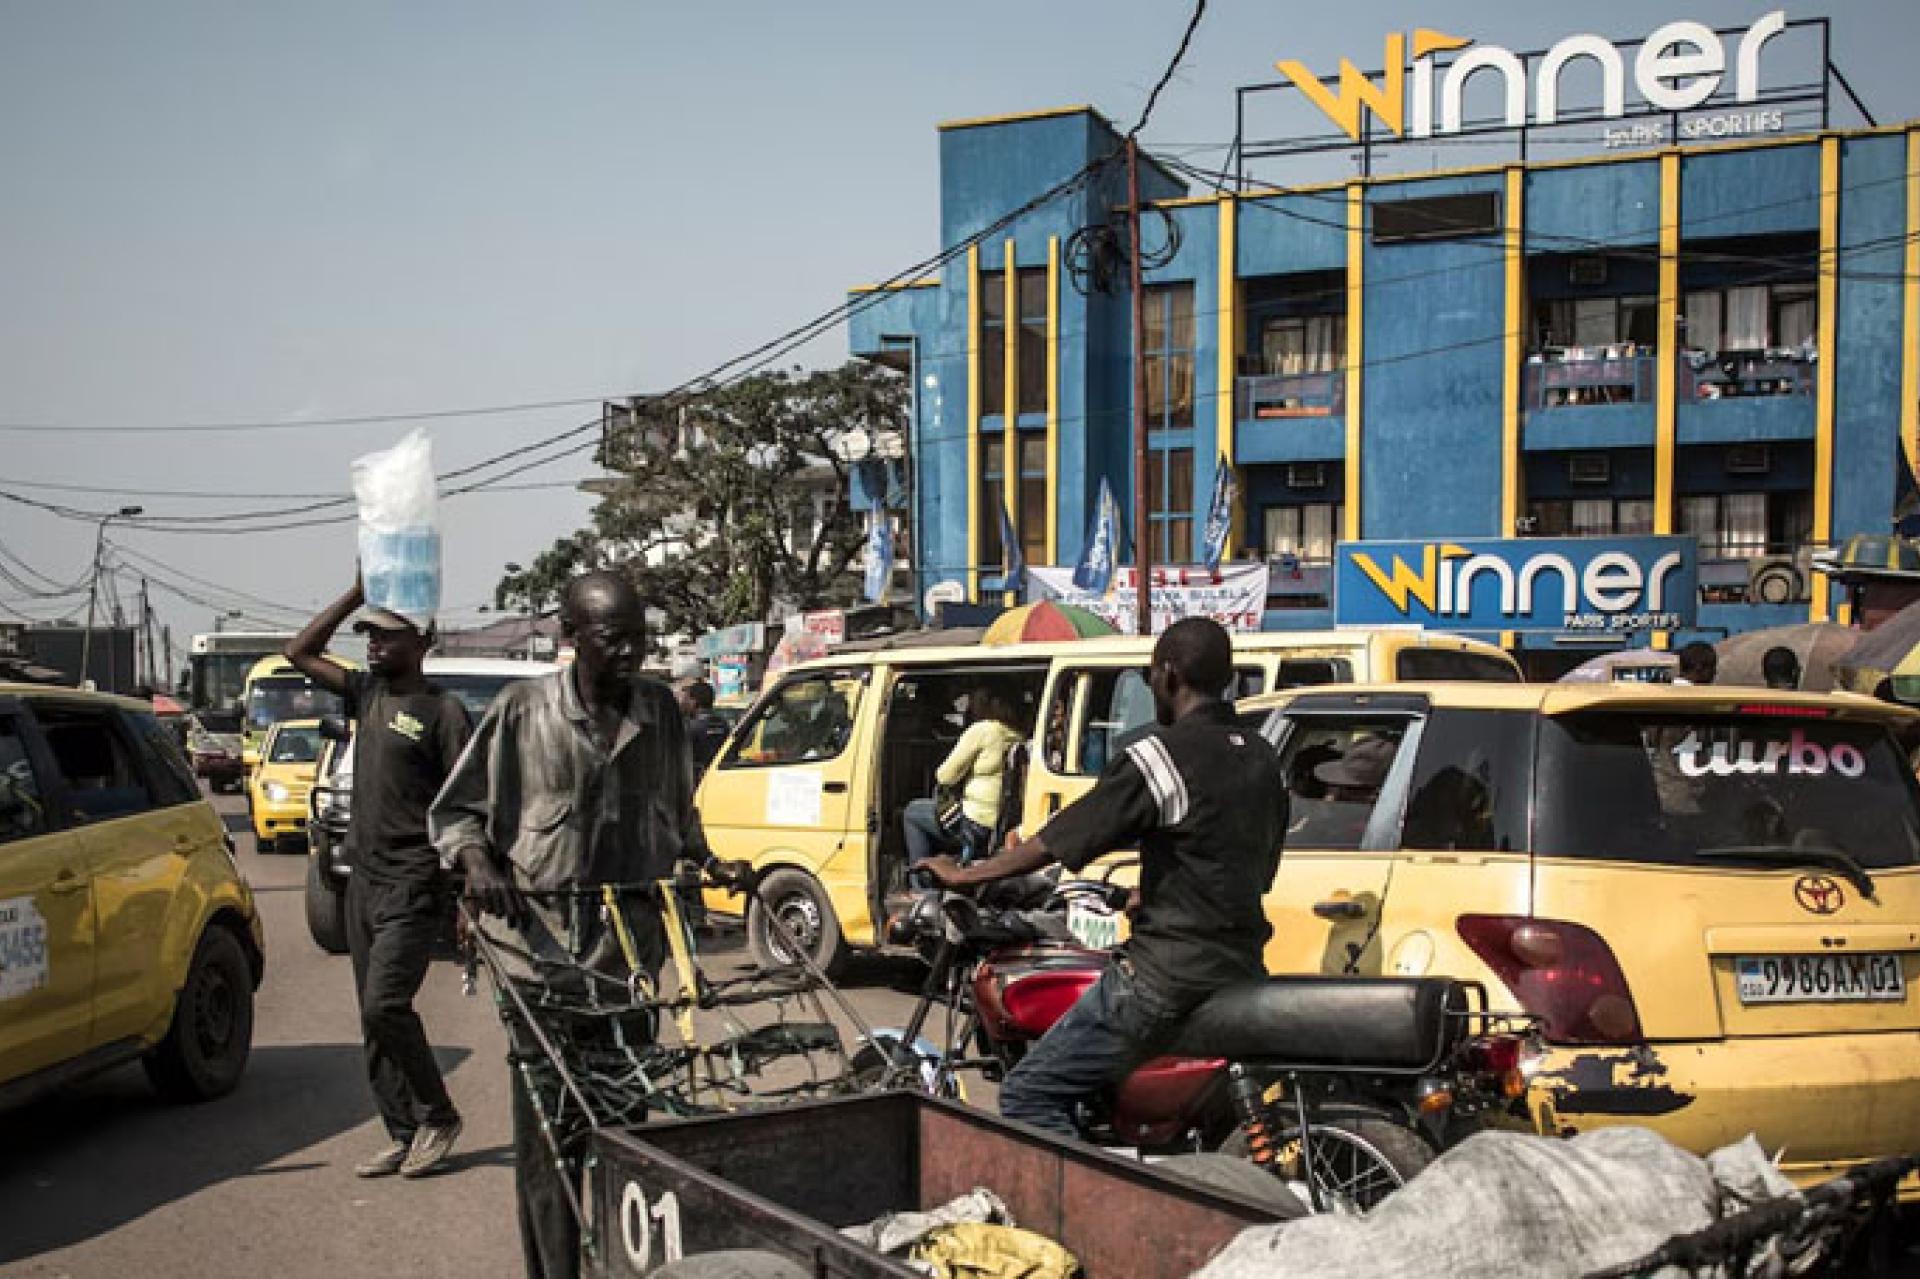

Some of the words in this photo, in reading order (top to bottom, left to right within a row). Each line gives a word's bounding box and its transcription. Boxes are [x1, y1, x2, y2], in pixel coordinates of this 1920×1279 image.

[1682, 110, 1783, 137] SPORTIFS
[1671, 729, 1866, 777] turbo
[622, 1180, 682, 1272] 01
